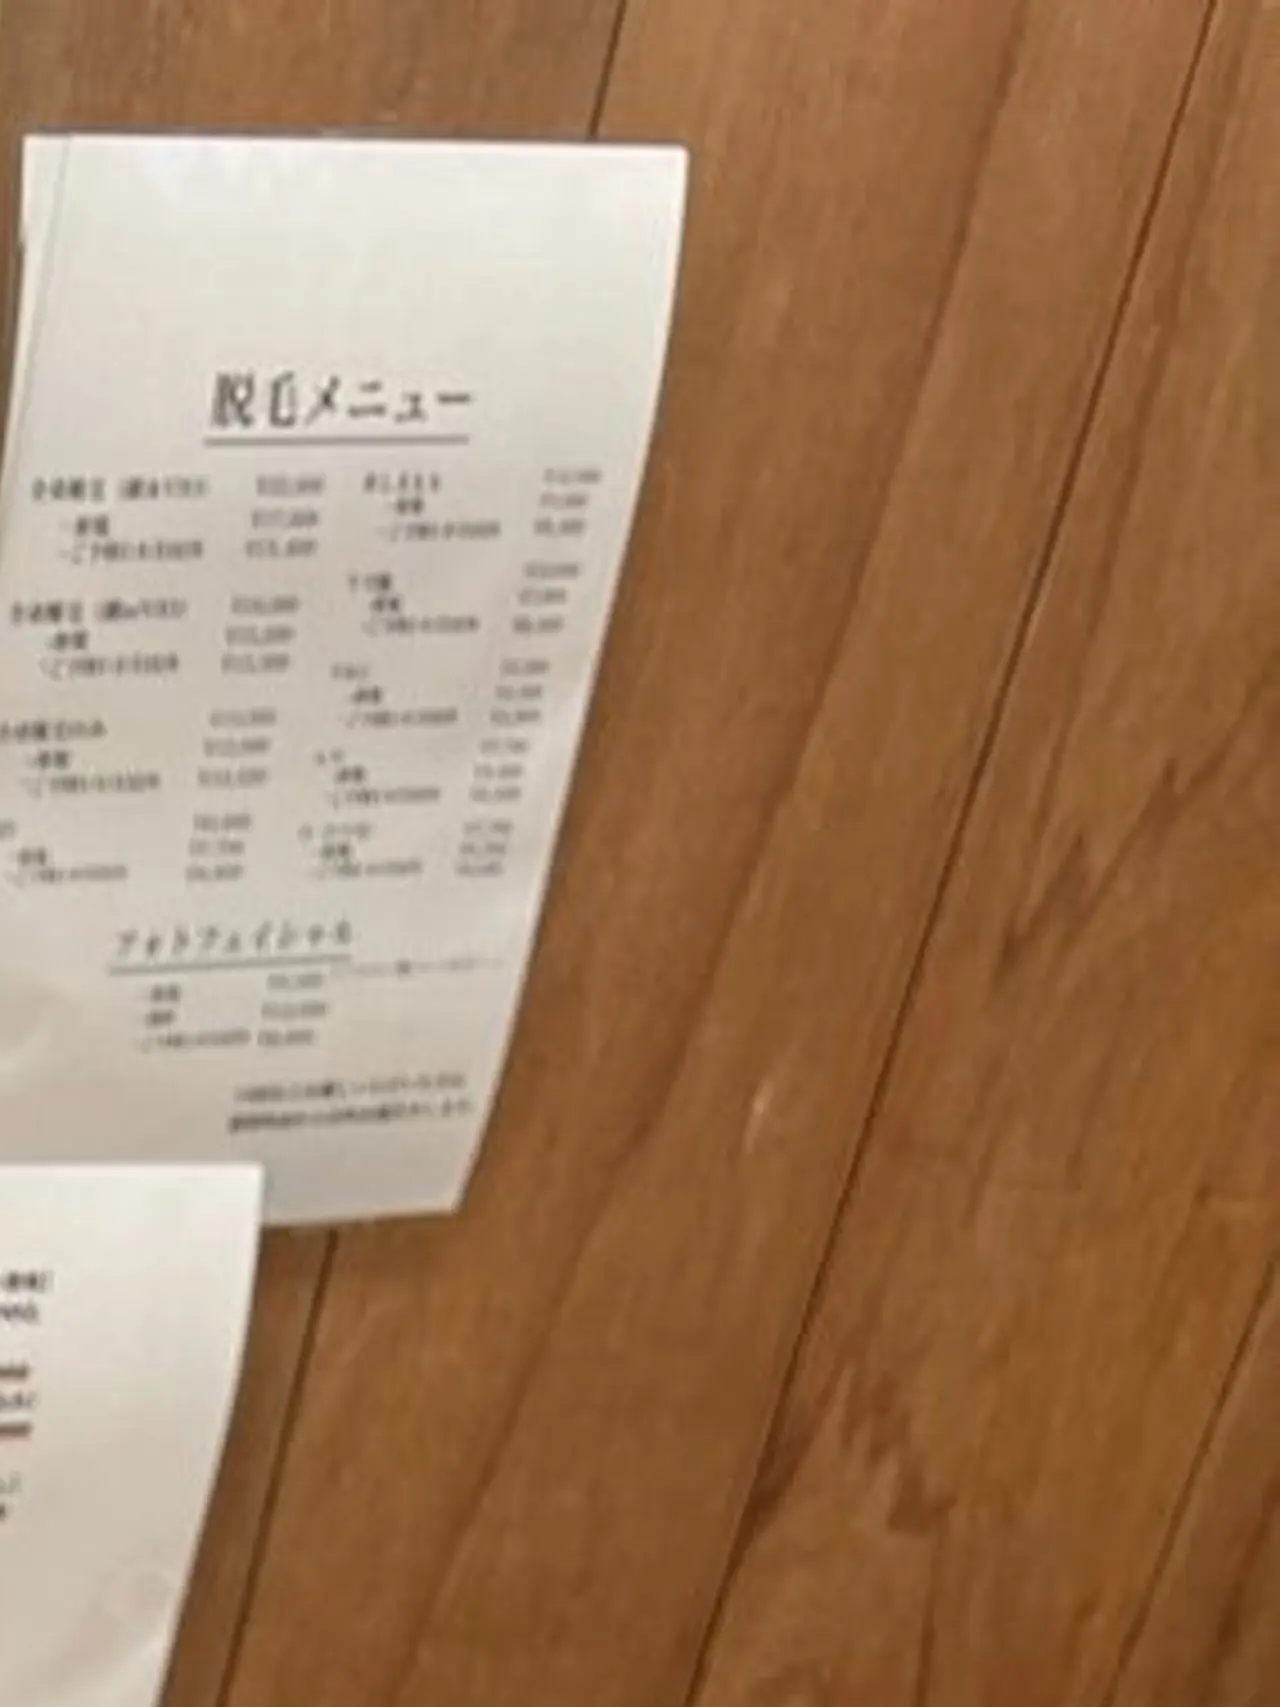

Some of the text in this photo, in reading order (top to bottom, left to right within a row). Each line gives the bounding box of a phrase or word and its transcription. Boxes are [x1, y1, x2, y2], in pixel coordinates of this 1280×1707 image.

[209, 369, 478, 431] 脱毛メニュー
